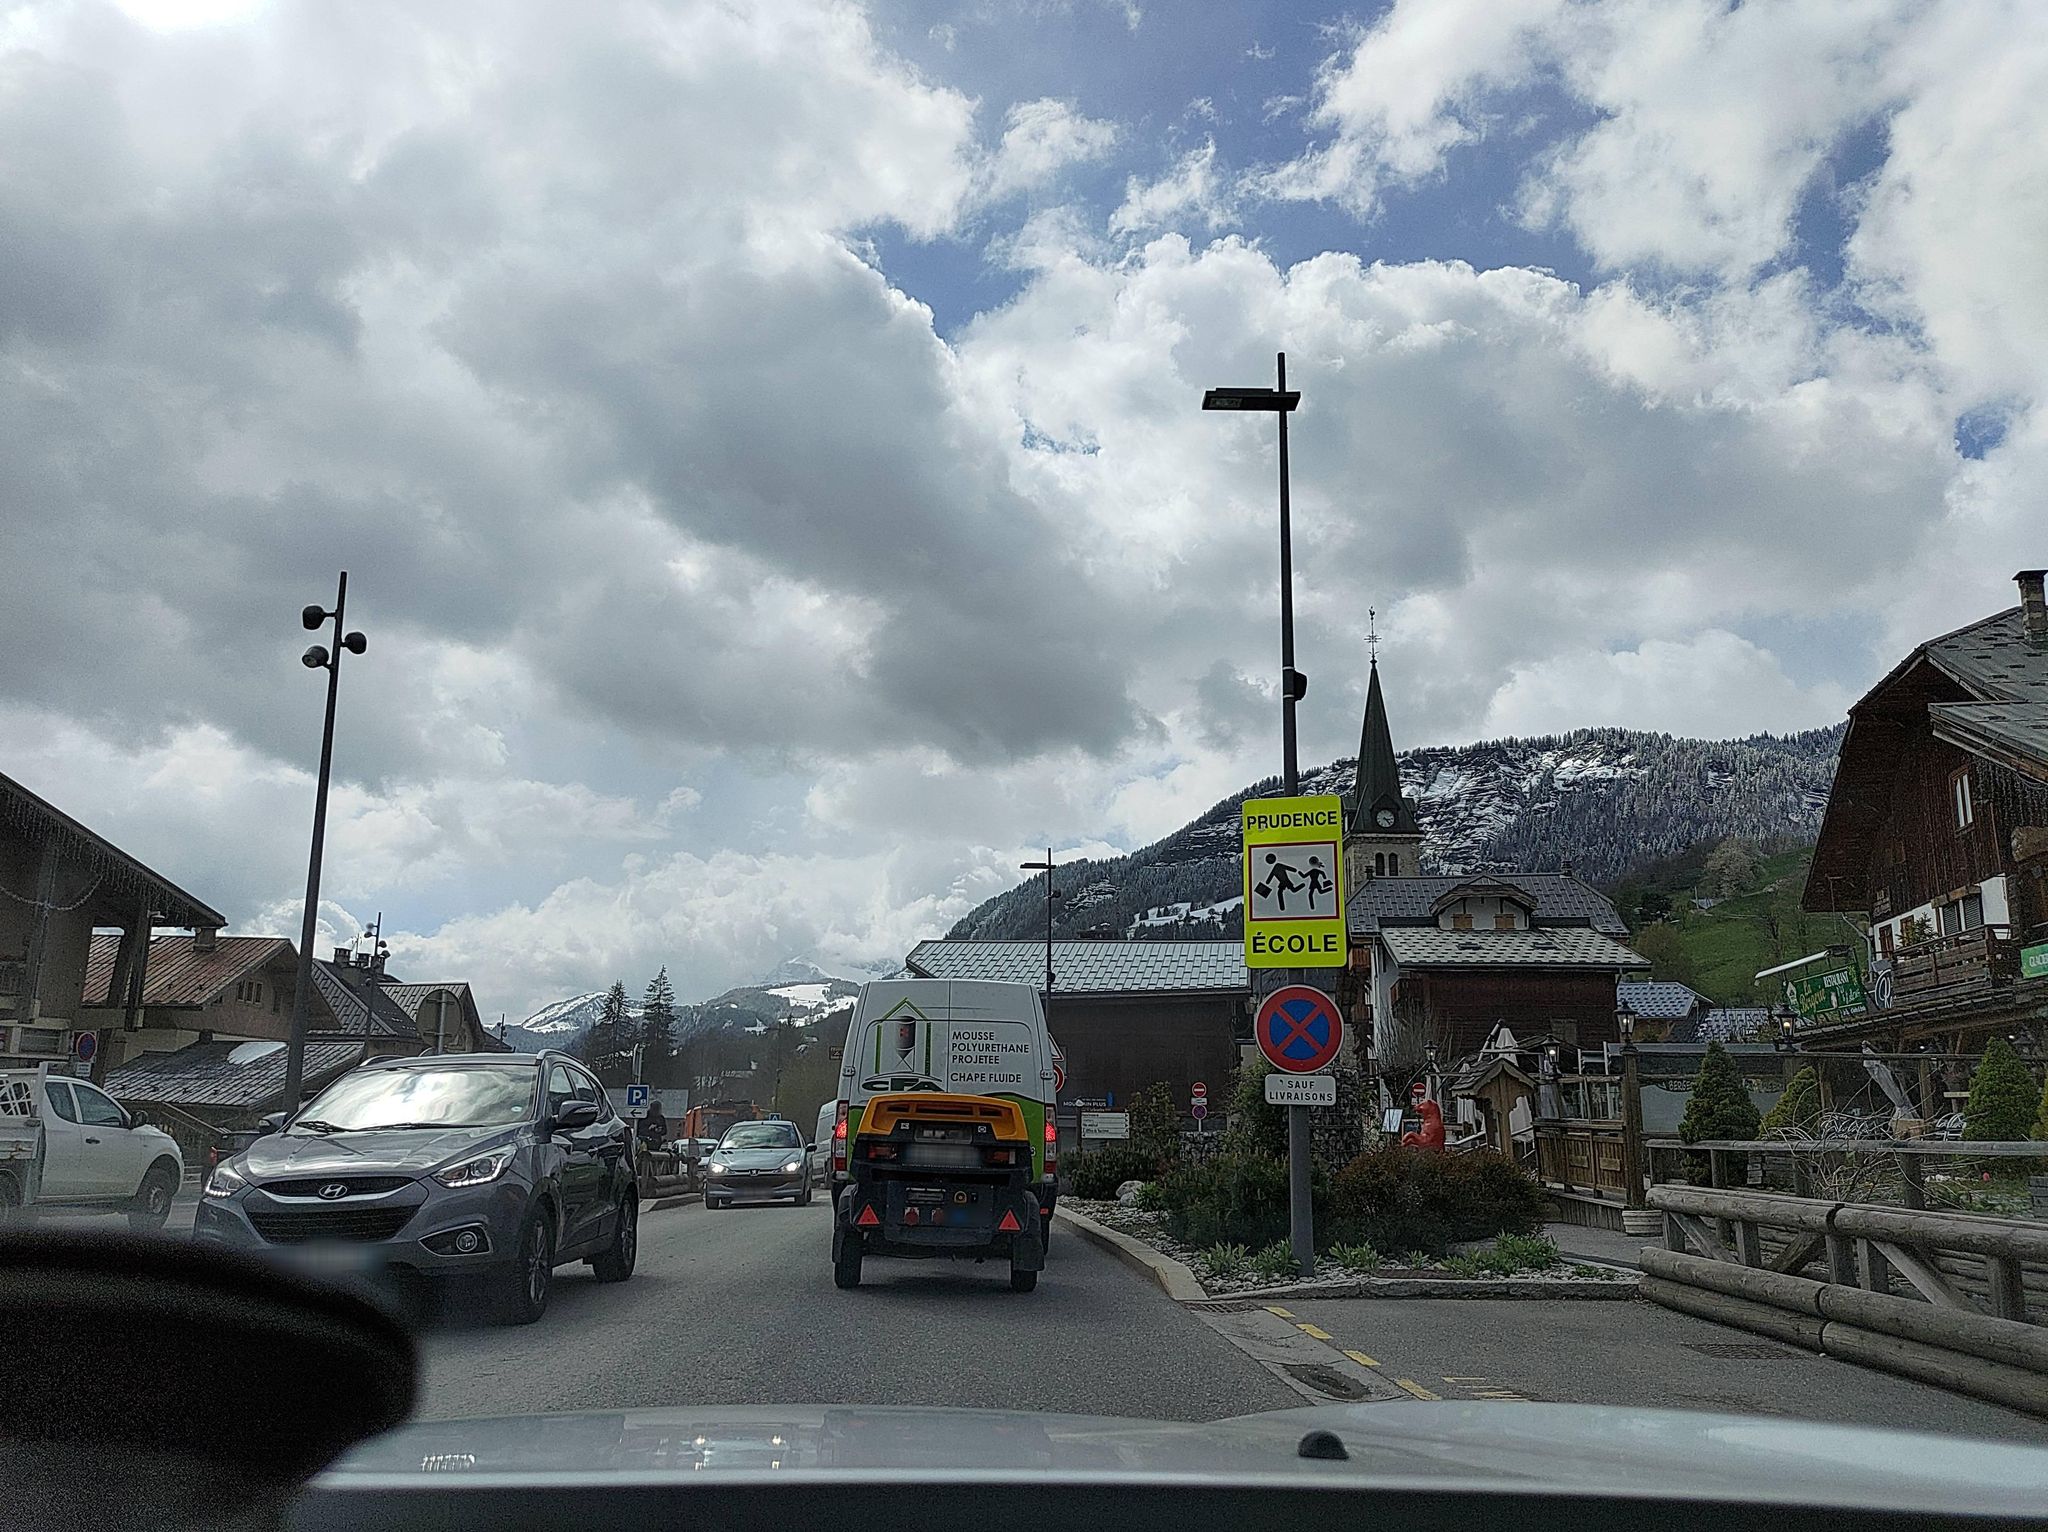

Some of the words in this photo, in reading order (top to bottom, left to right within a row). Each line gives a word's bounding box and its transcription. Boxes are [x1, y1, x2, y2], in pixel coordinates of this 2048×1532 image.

[1246, 811, 1338, 830] PRUDENCE
[1252, 931, 1338, 954] ÉCOLE
[952, 1031, 995, 1041] MOUSSE
[951, 1042, 1030, 1053] POLYURETHANE
[952, 1054, 1000, 1065] PROJETEE
[950, 1072, 986, 1082] CHAPE
[989, 1073, 1022, 1083] FLUIDE
[861, 1077, 946, 1092] CFA
[1287, 1080, 1315, 1089] SAUF
[1269, 1091, 1333, 1102] LIVRAISONS
